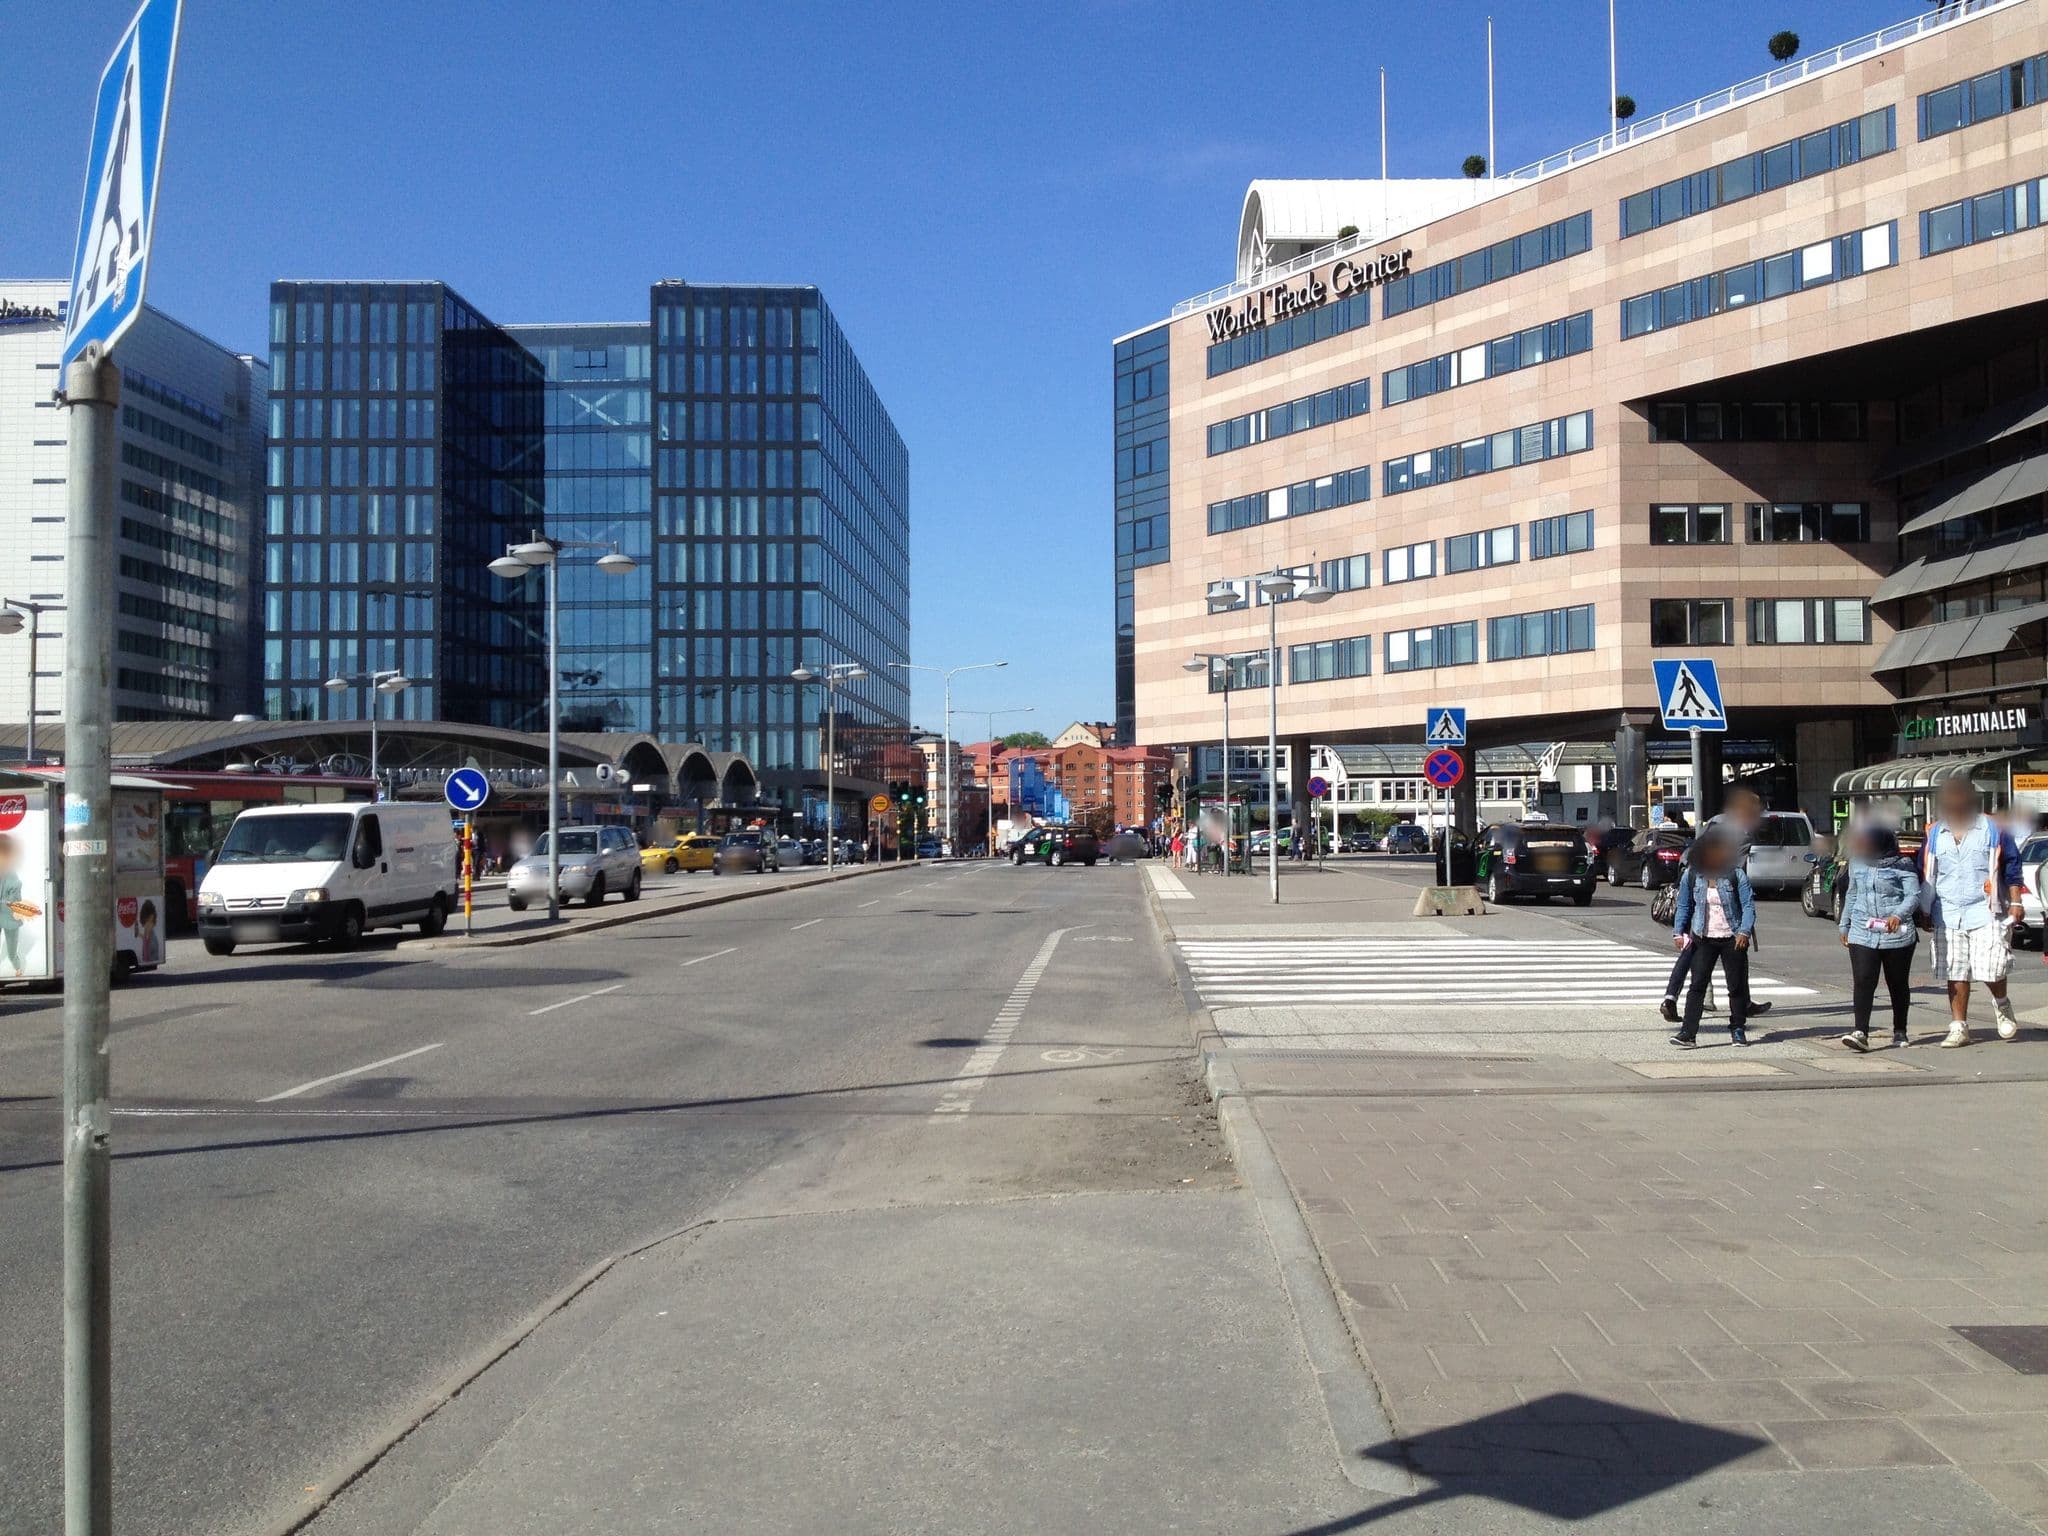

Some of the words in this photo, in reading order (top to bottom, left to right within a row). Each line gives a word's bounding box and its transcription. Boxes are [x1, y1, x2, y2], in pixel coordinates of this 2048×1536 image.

[1204, 291, 1266, 340] World
[1267, 271, 1327, 320] Trade
[1330, 247, 1412, 298] Center
